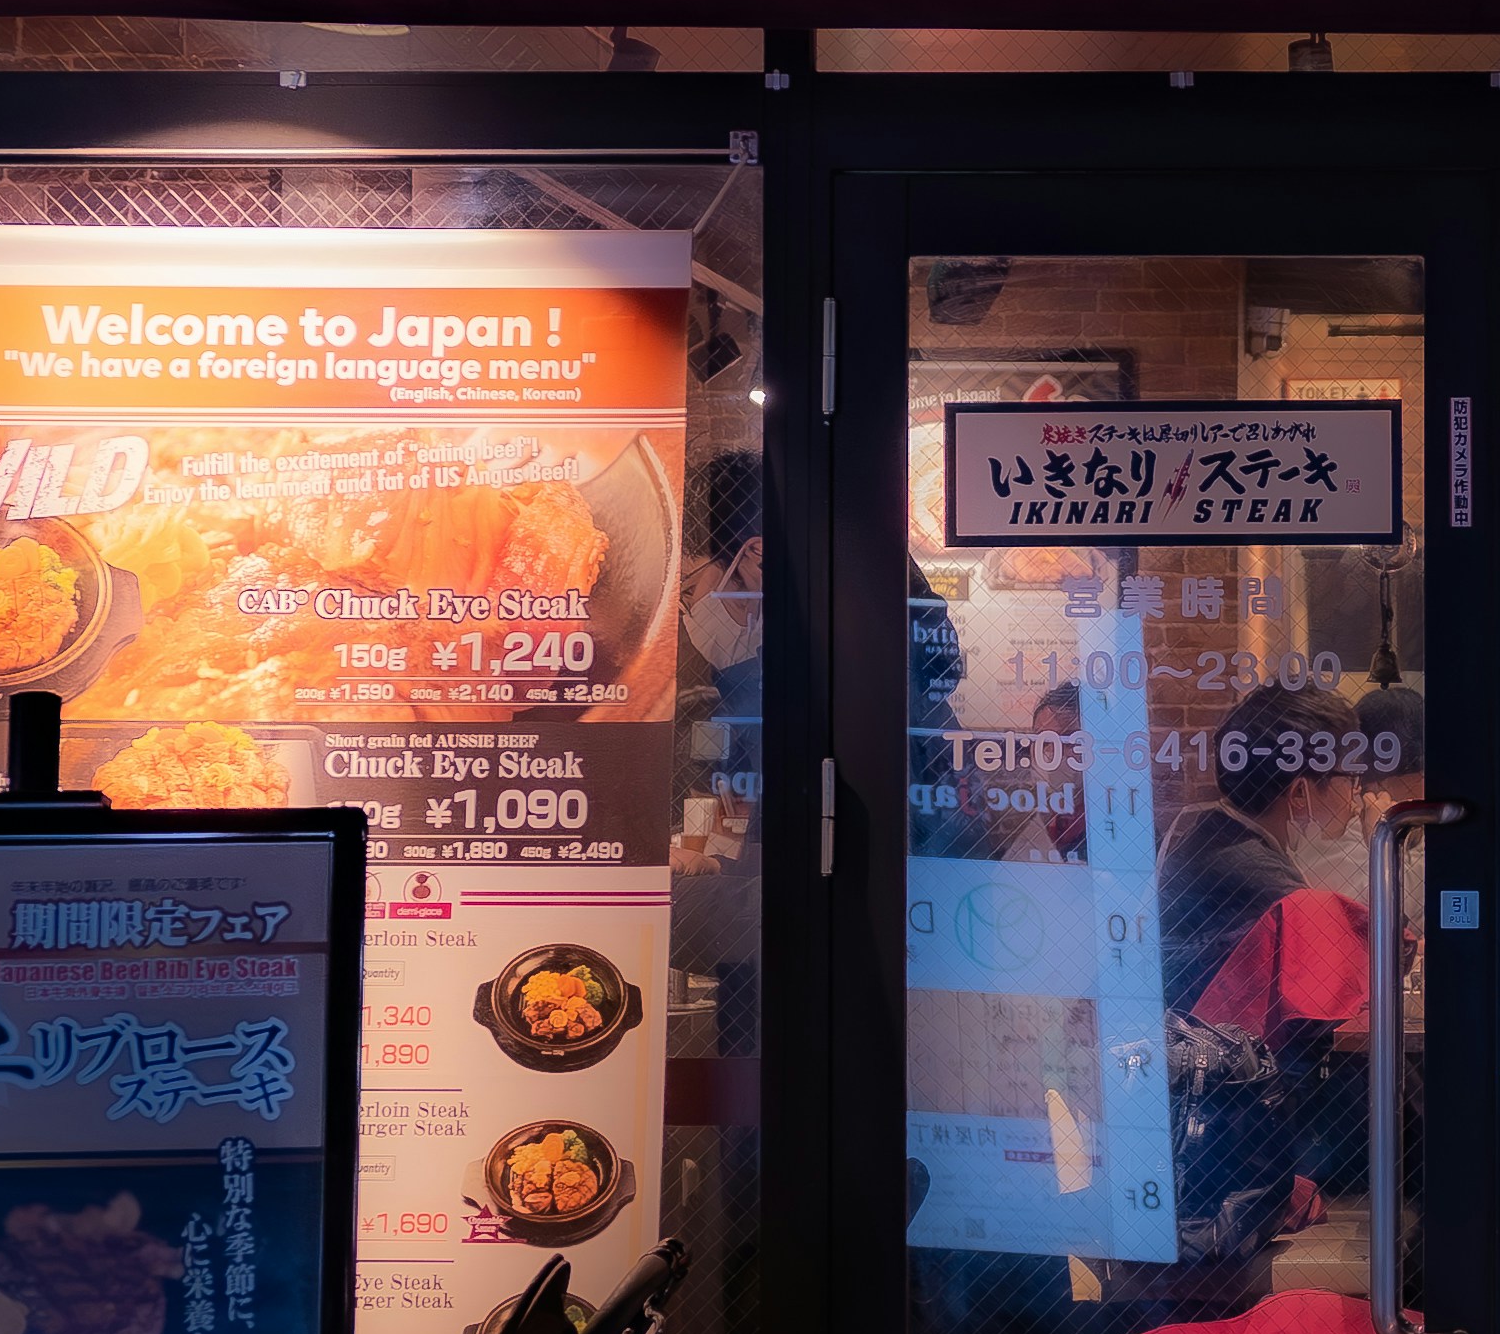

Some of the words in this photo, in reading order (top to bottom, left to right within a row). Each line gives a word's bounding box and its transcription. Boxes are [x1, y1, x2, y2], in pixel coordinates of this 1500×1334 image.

[41, 303, 288, 346] Welcome
[298, 307, 357, 347] to
[366, 306, 532, 357] Japan
[4, 349, 74, 378] "We
[81, 350, 162, 378] have
[169, 357, 190, 379] a
[197, 350, 317, 386] foreign
[325, 352, 481, 386] language
[488, 352, 596, 380] menu"
[389, 387, 454, 403] (English,
[456, 387, 519, 402] Chinese,
[522, 387, 582, 403] Korean)
[181, 452, 235, 477] Fulfill
[239, 451, 270, 474] the
[275, 449, 379, 473] excitement
[384, 443, 404, 466] of
[409, 442, 475, 466] "eating
[987, 447, 1157, 500] いきなり
[1198, 447, 1338, 496] ステーキ
[1452, 399, 1471, 526] 防犯カメラ作動中
[143, 482, 194, 507] Enjoy
[199, 479, 230, 502] the
[235, 476, 276, 500] lean
[282, 472, 331, 497] meat
[335, 471, 371, 495] and
[377, 468, 405, 492] fat
[409, 466, 430, 490] of
[435, 466, 461, 488] US
[466, 463, 525, 489] Angus
[529, 458, 579, 482] Beef!
[1008, 500, 1154, 525] IKINARI
[1193, 499, 1324, 524] STEAK
[314, 589, 419, 620] Chuck
[427, 589, 490, 623] Eye
[498, 588, 591, 620] Steak
[1061, 575, 1285, 620] 営業時間
[333, 643, 408, 671] 150g
[431, 631, 594, 675] ¥1,240
[294, 687, 325, 701] 200g
[329, 683, 395, 701] ¥1,590
[410, 687, 441, 701] 300g
[448, 683, 514, 702] ¥2,140
[525, 687, 557, 702] 450g
[563, 683, 628, 702] ¥2,840
[325, 734, 365, 749] Short
[367, 734, 406, 750] grain
[409, 733, 432, 749] fed
[435, 734, 495, 749] AUSSIE
[497, 734, 540, 749] BEEF
[943, 730, 1401, 773] Tel:03-6416-3329
[324, 751, 425, 779] Chuck
[429, 751, 490, 781] Eye
[498, 751, 584, 779] Steak
[424, 788, 589, 834] ¥1,090
[403, 845, 436, 859] 300g
[441, 841, 508, 861] ¥1,890
[520, 845, 552, 859] 450g
[557, 841, 624, 861] ¥2,490
[1449, 915, 1472, 925] PULL
[1450, 895, 1469, 915] 引
[11, 899, 292, 949] 期間限定フェア
[425, 931, 478, 947] Steak
[101, 959, 149, 981] Beef
[156, 958, 189, 980] Rib
[195, 957, 230, 982] Eye
[236, 956, 297, 979] Steak
[34, 1015, 293, 1082] リブロース
[110, 1070, 293, 1122] ステーキ
[417, 1102, 470, 1118] Steak
[413, 1119, 467, 1136] Steak
[361, 1213, 449, 1236] ¥1,690
[390, 1273, 445, 1291] Steak
[401, 1292, 455, 1309] Steak
